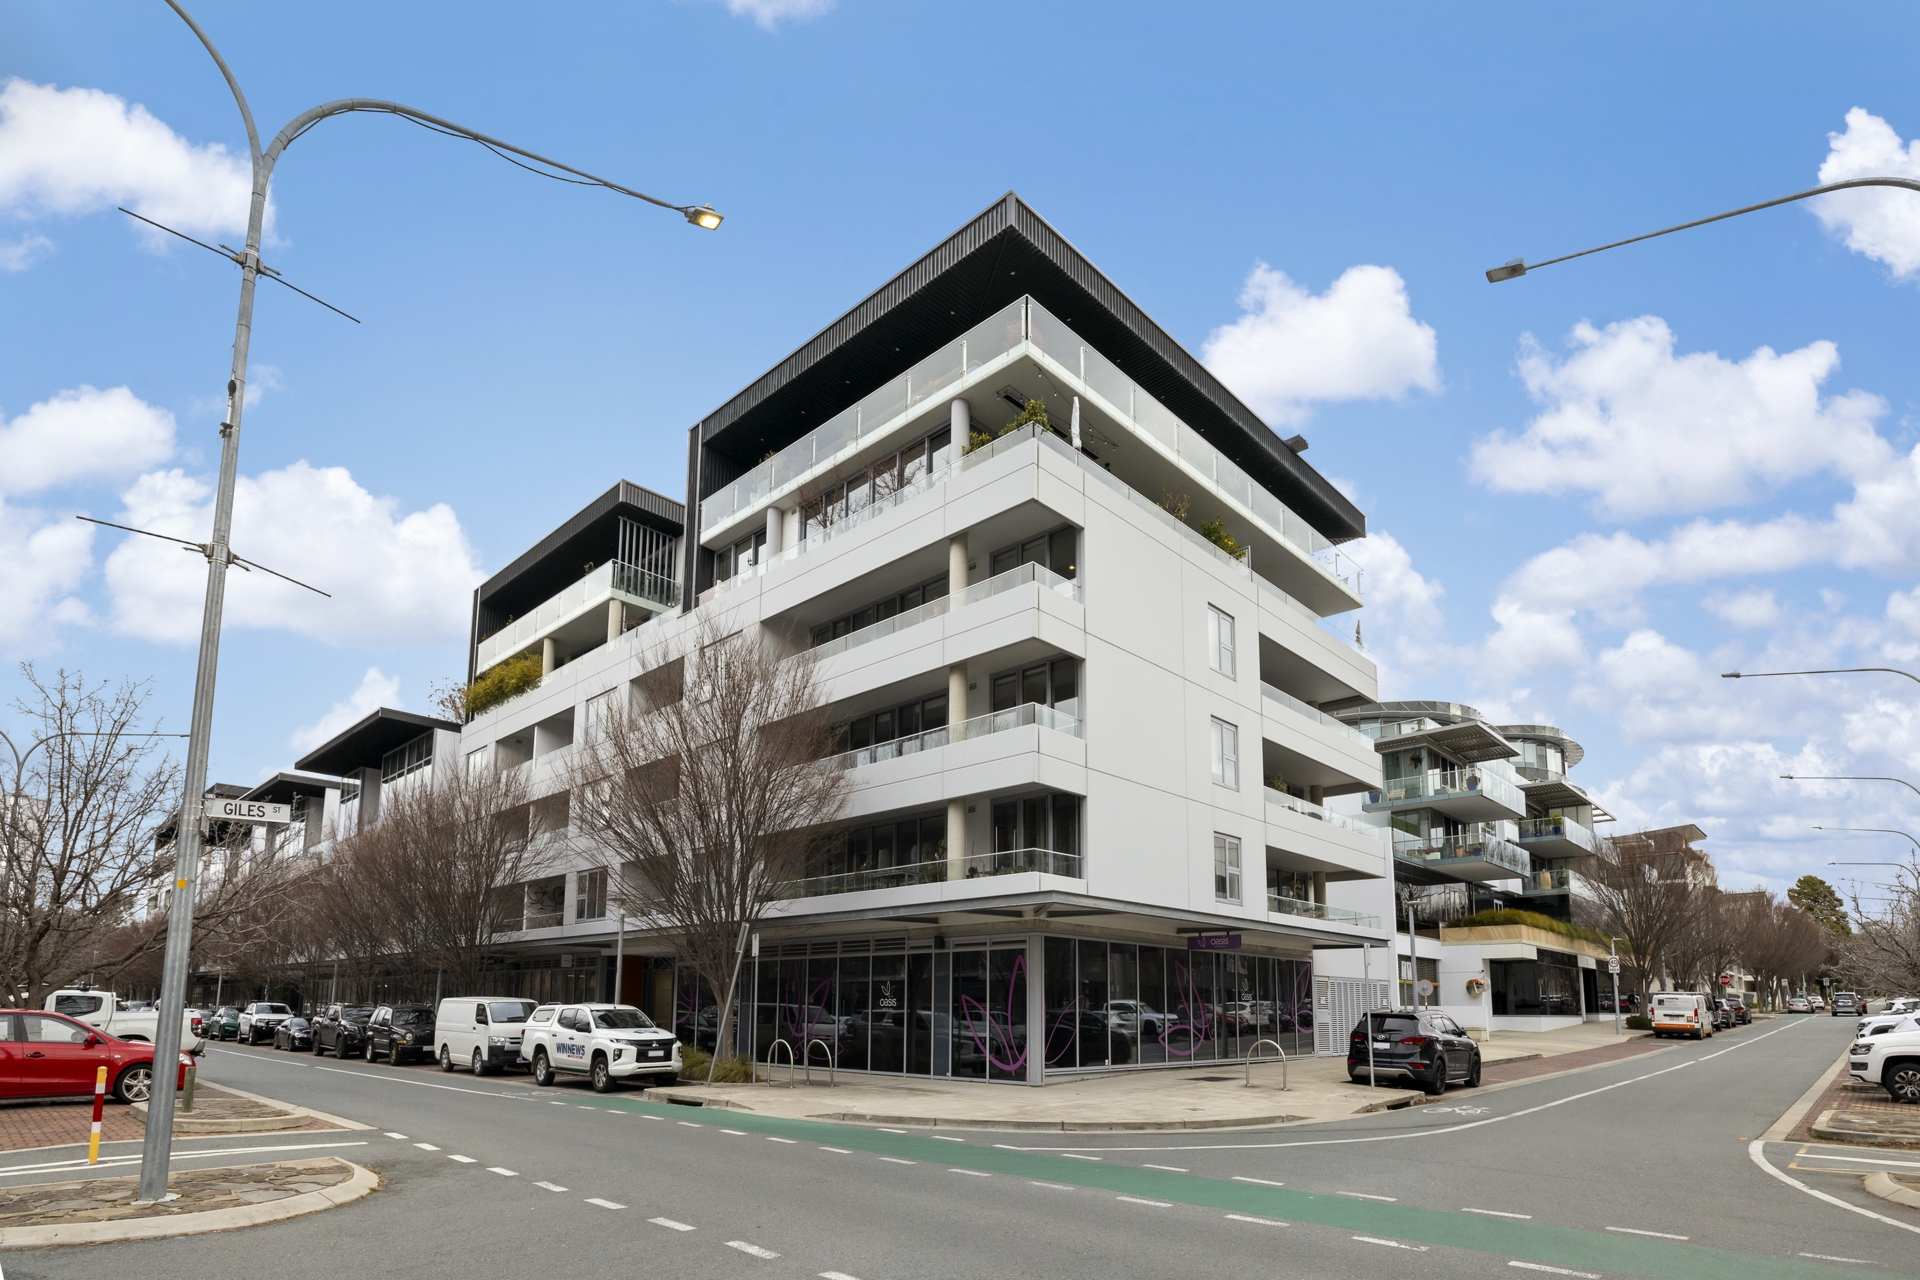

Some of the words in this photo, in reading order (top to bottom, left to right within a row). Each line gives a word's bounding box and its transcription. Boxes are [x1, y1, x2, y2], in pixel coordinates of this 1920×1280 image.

[223, 802, 265, 818] GILES
[272, 806, 282, 814] ST
[1210, 935, 1229, 946] oasis
[879, 995, 897, 1007] oasis
